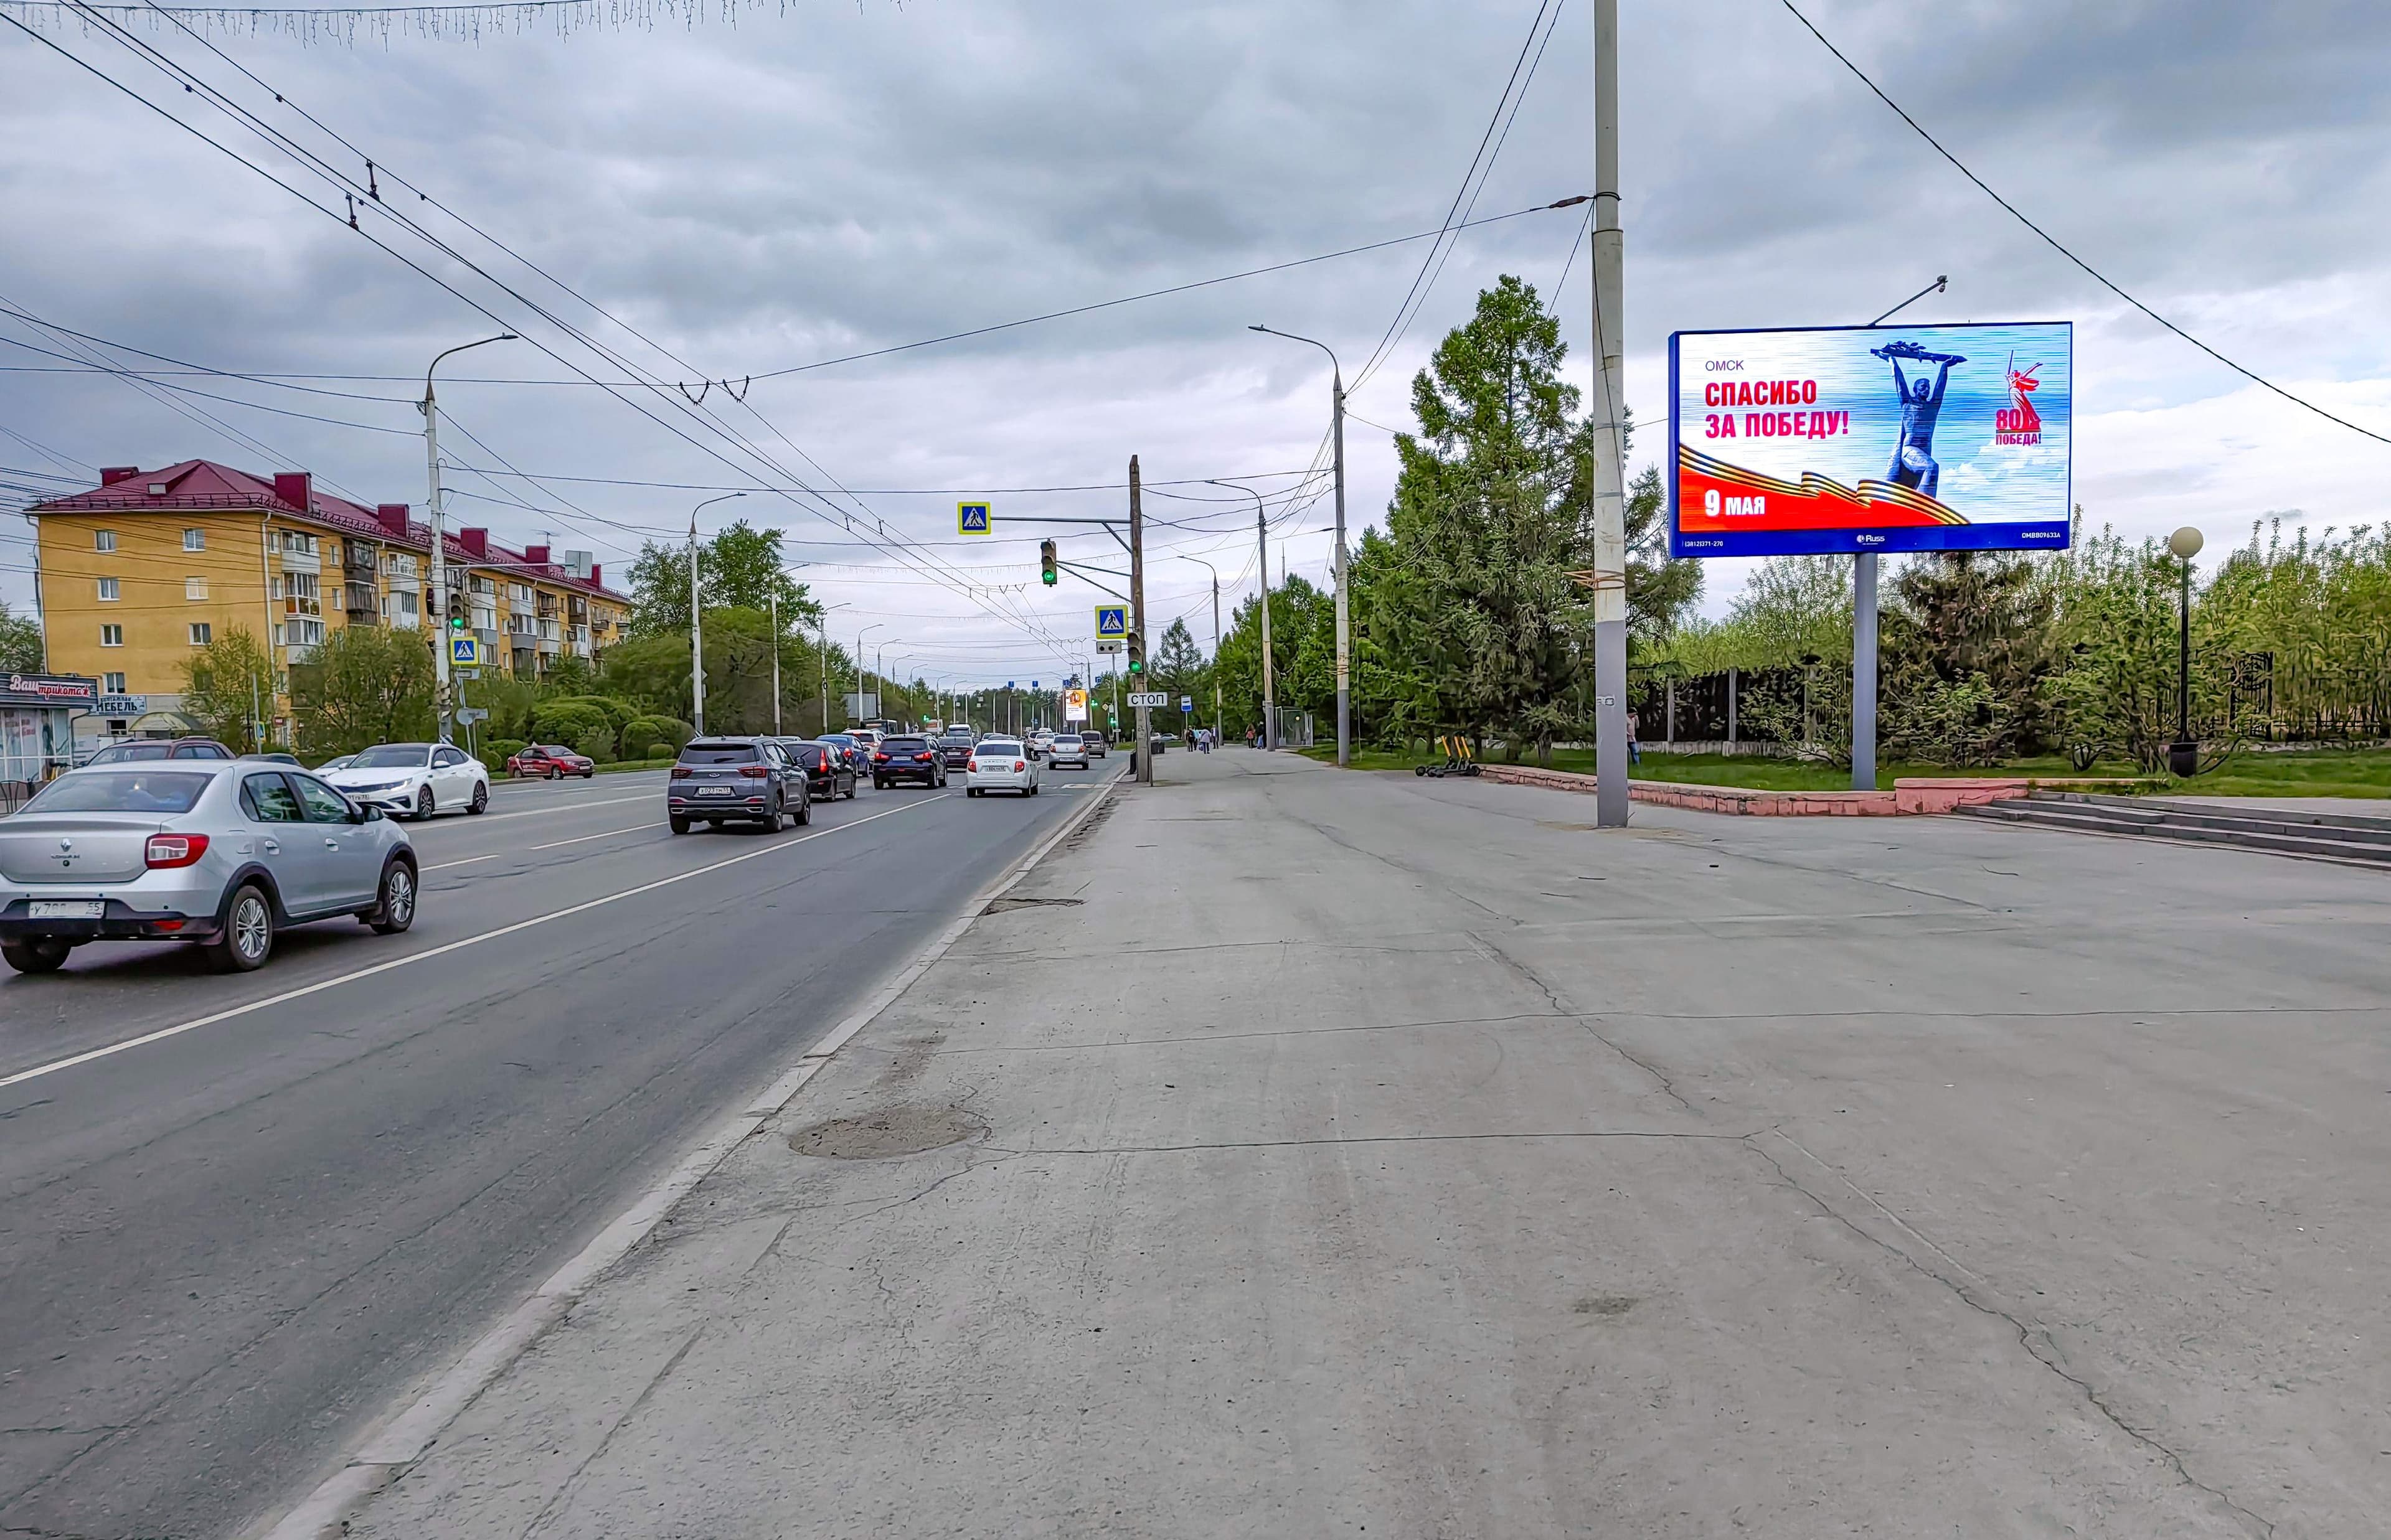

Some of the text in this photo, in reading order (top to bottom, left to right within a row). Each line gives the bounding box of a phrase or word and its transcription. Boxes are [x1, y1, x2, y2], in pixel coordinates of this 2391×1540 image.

[1705, 360, 1744, 372] ОМСК
[1705, 379, 1817, 407] СПАСИБО
[1705, 410, 1849, 439] ЗА ПОБЕДУ!
[1996, 408, 2021, 430] 80
[1996, 433, 2042, 446] ПОБЕДА!
[1705, 489, 1765, 517] 9 МАЯ
[10, 674, 39, 692] Ваш
[97, 701, 137, 711] МЕБЕЛЬ
[1131, 694, 1164, 705] СТОП
